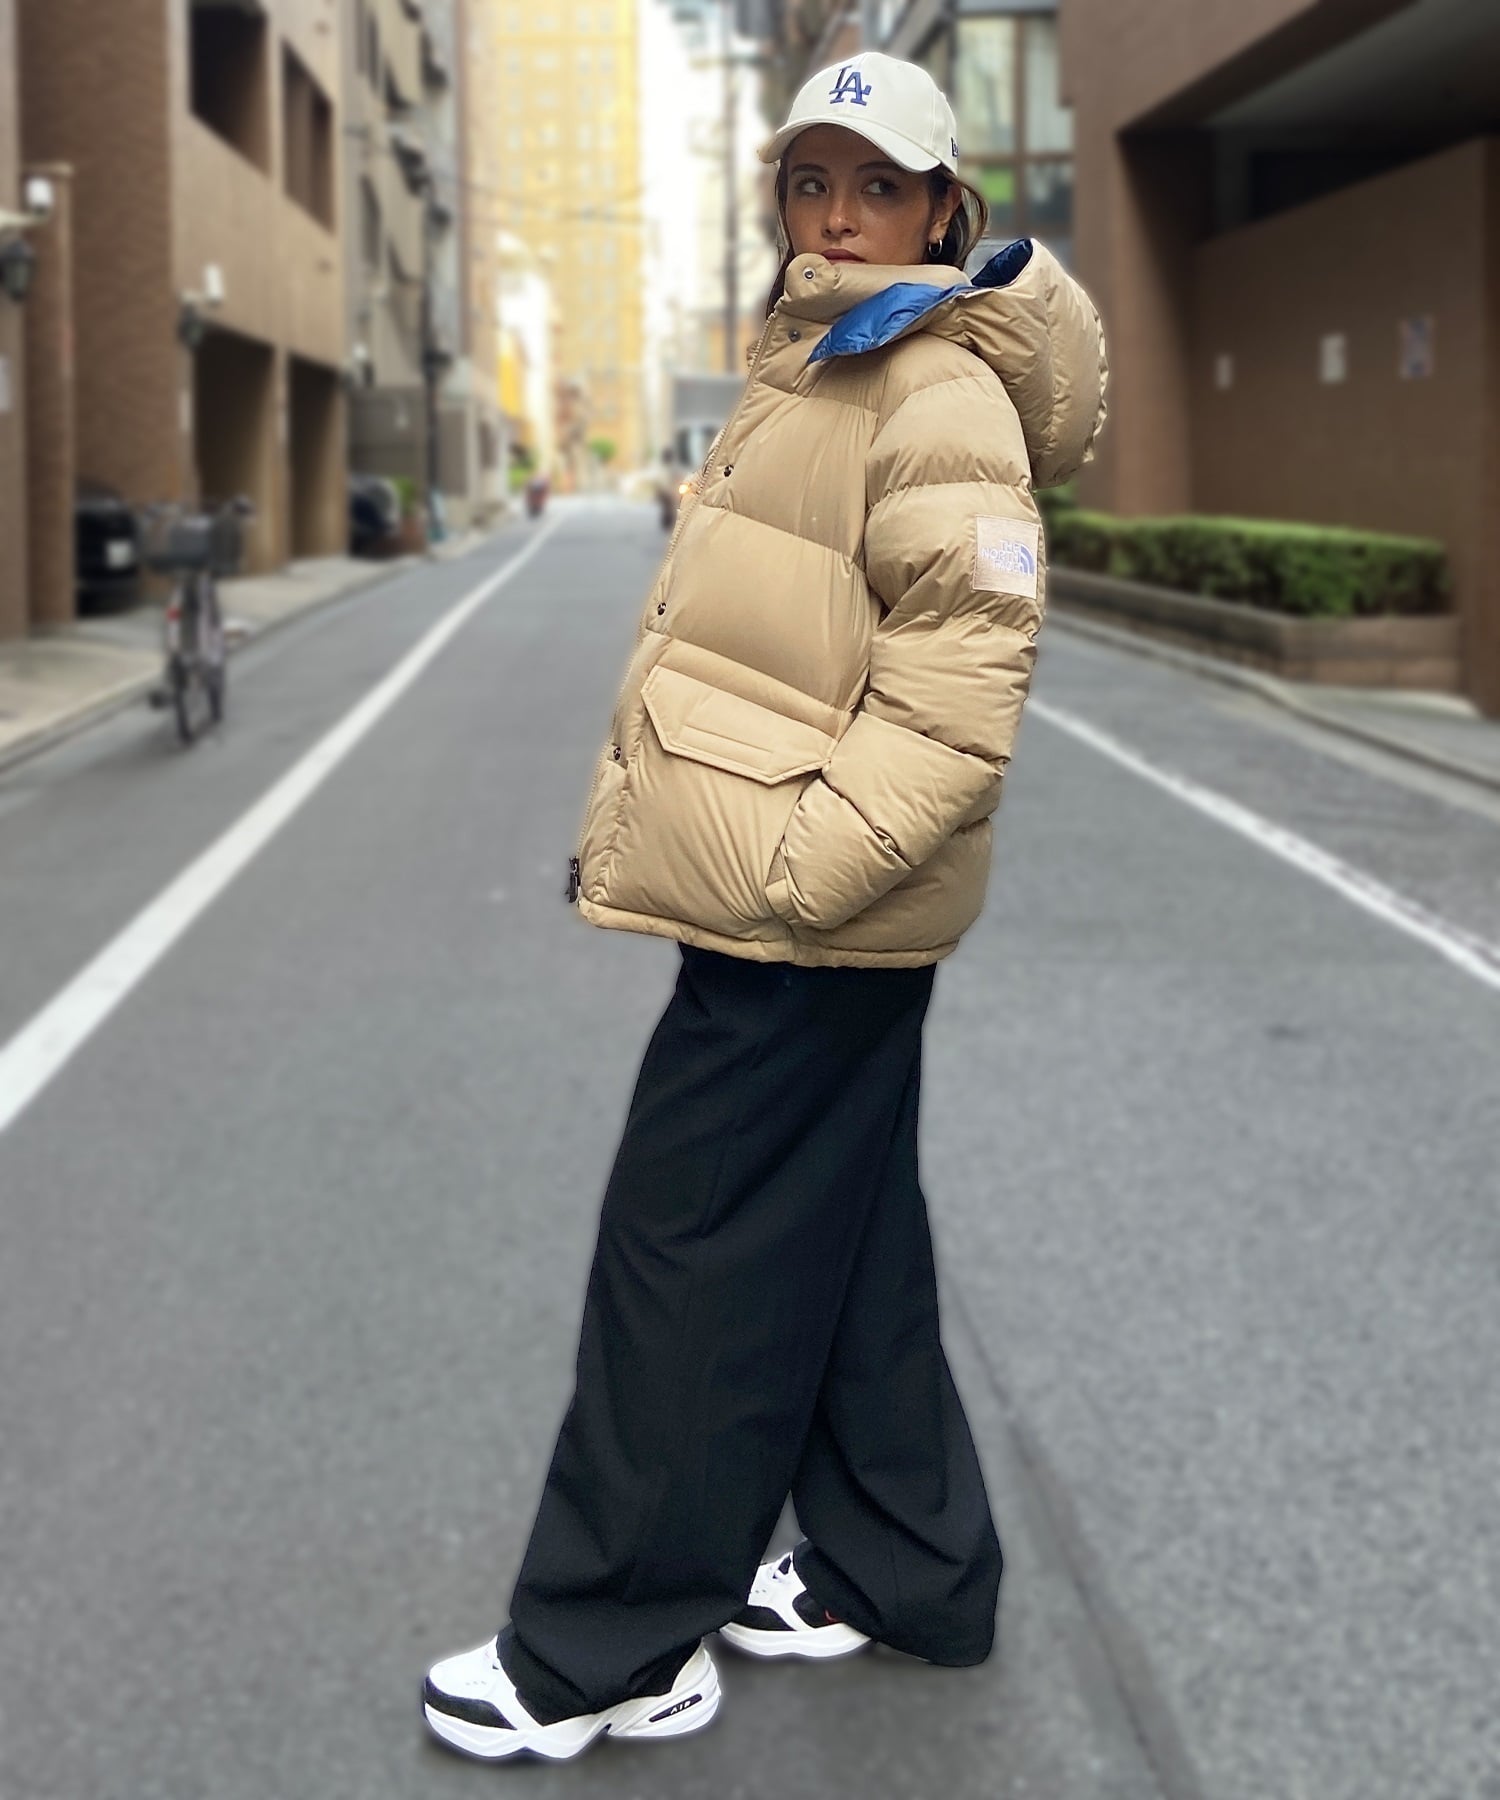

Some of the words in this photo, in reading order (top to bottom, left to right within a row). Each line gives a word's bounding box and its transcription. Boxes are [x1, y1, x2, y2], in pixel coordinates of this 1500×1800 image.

[829, 65, 872, 106] LA
[1000, 540, 1020, 553] THE
[981, 547, 1020, 563] NORTH
[994, 560, 1020, 572] FACE
[670, 1700, 691, 1715] AIR
